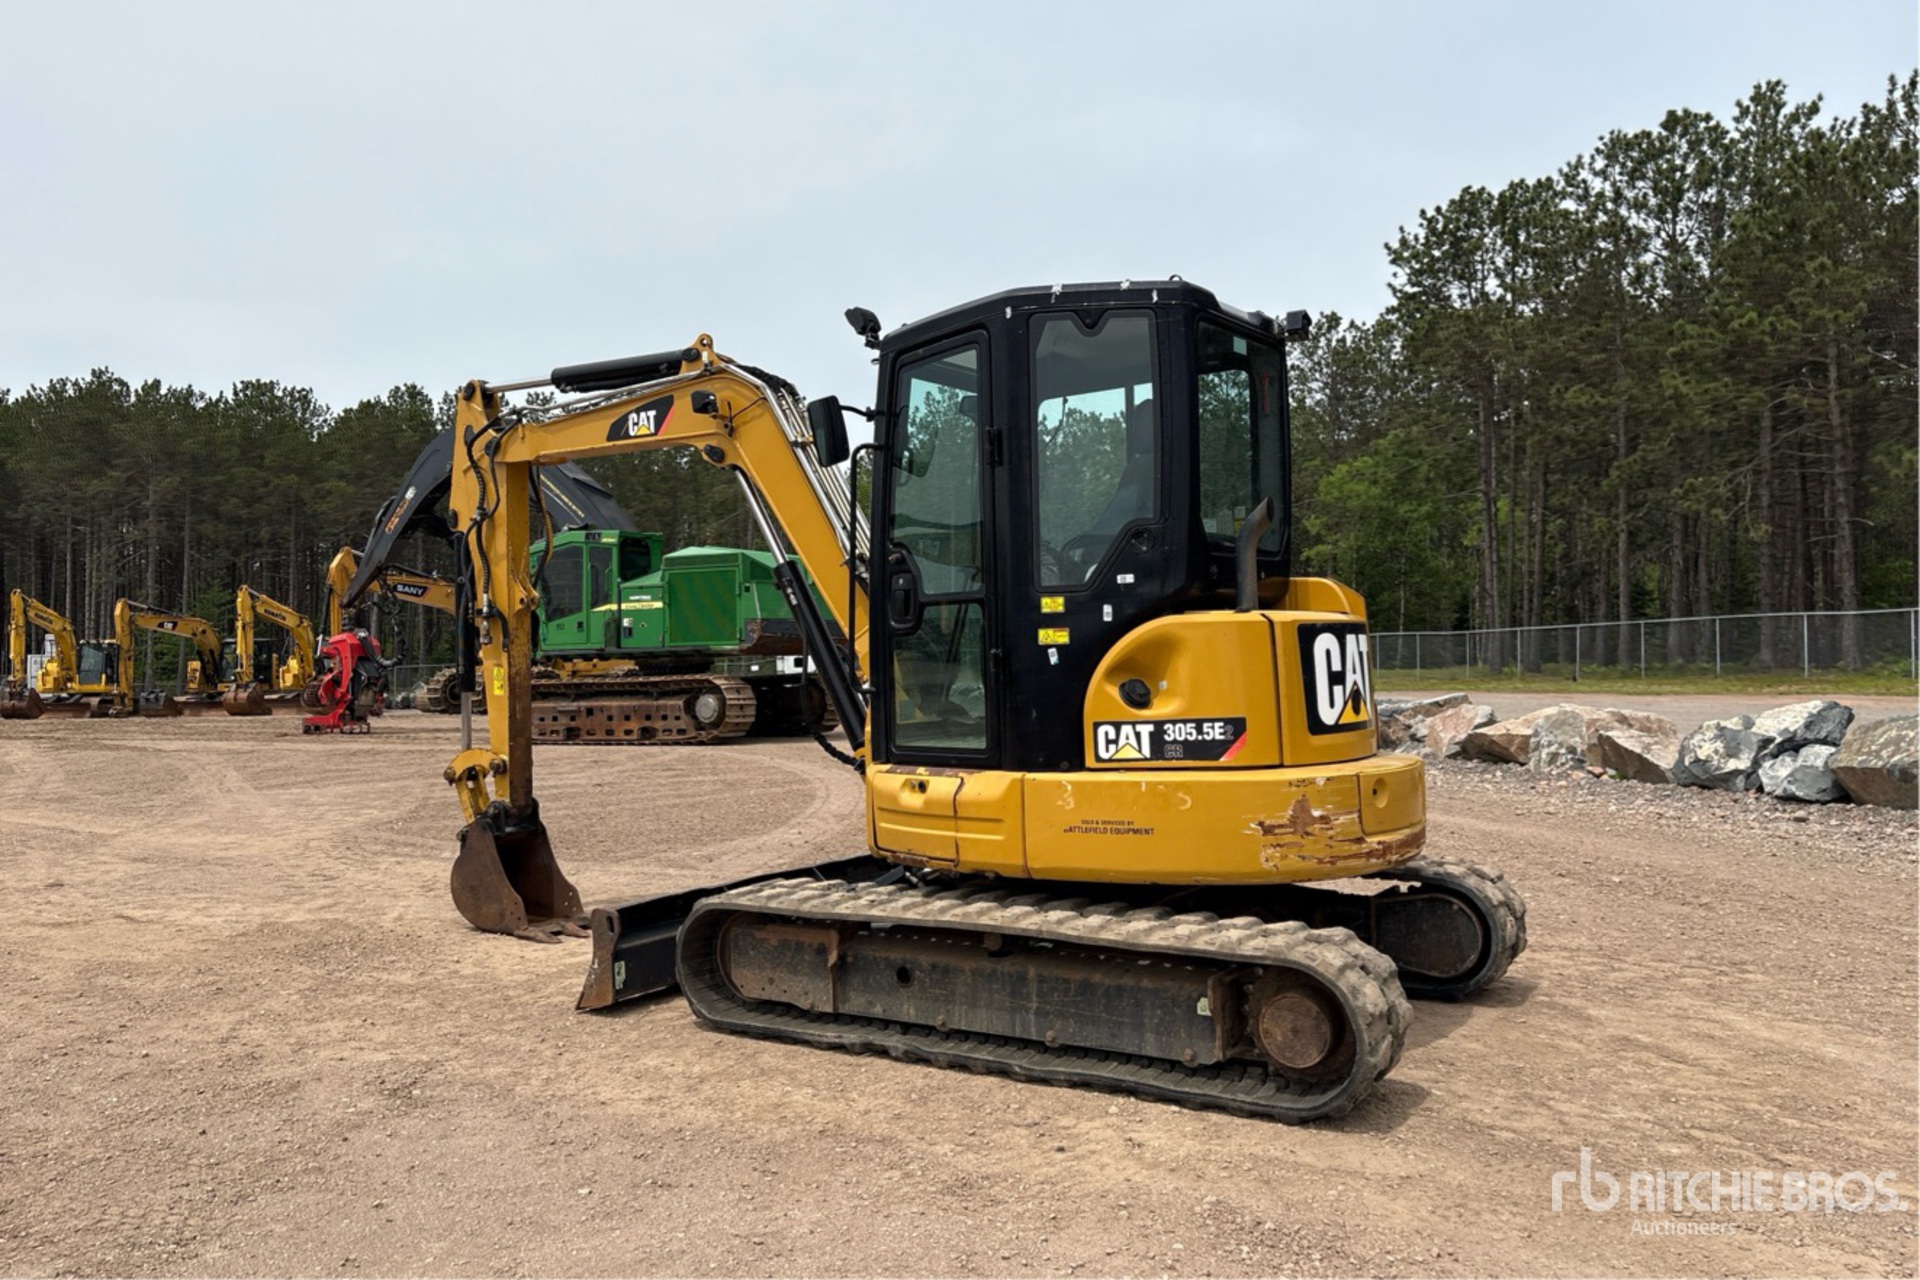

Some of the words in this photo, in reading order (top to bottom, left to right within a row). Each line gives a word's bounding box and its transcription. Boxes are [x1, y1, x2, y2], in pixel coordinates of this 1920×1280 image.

[628, 410, 657, 437] CAT
[397, 584, 424, 596] SANY
[1097, 724, 1155, 760] CAT
[1164, 744, 1184, 758] CR
[1109, 827, 1155, 836] EQUIPMENT
